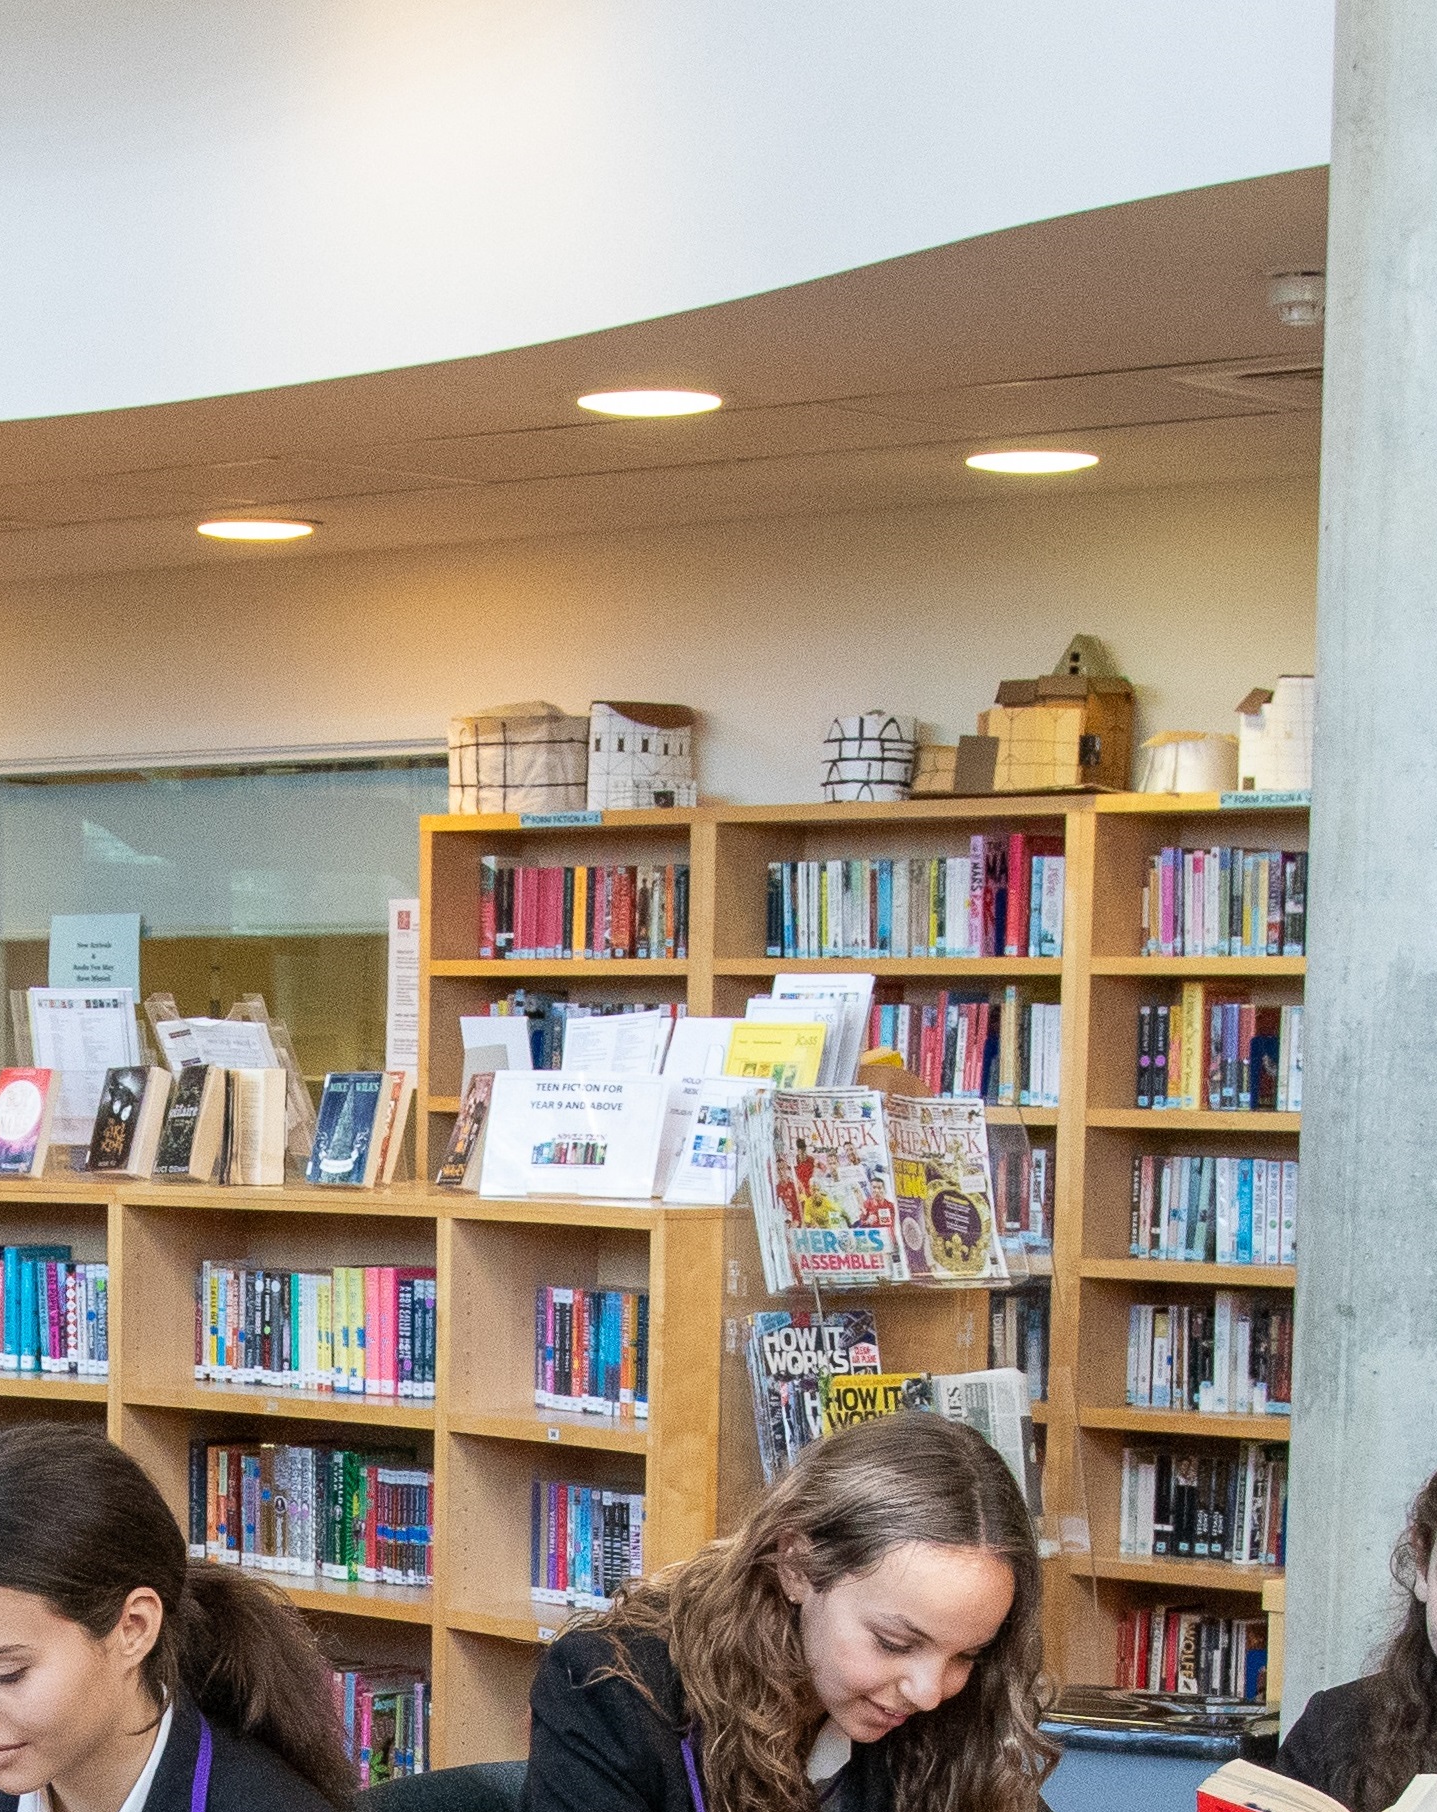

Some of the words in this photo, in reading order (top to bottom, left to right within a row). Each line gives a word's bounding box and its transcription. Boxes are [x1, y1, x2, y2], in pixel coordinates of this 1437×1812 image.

[535, 1083, 559, 1093] TEEN
[603, 1084, 623, 1094] FOR
[530, 1101, 556, 1111] YEAR
[557, 1101, 563, 1110] 9
[565, 1101, 586, 1111] AND
[589, 1102, 624, 1112] ABOVE
[800, 1253, 886, 1271] ASSEMBLE!
[763, 1327, 818, 1351] HOW
[822, 1326, 845, 1350] IT
[767, 1349, 850, 1376] WORKS
[829, 1387, 877, 1411] HOW
[883, 1386, 903, 1409] IT
